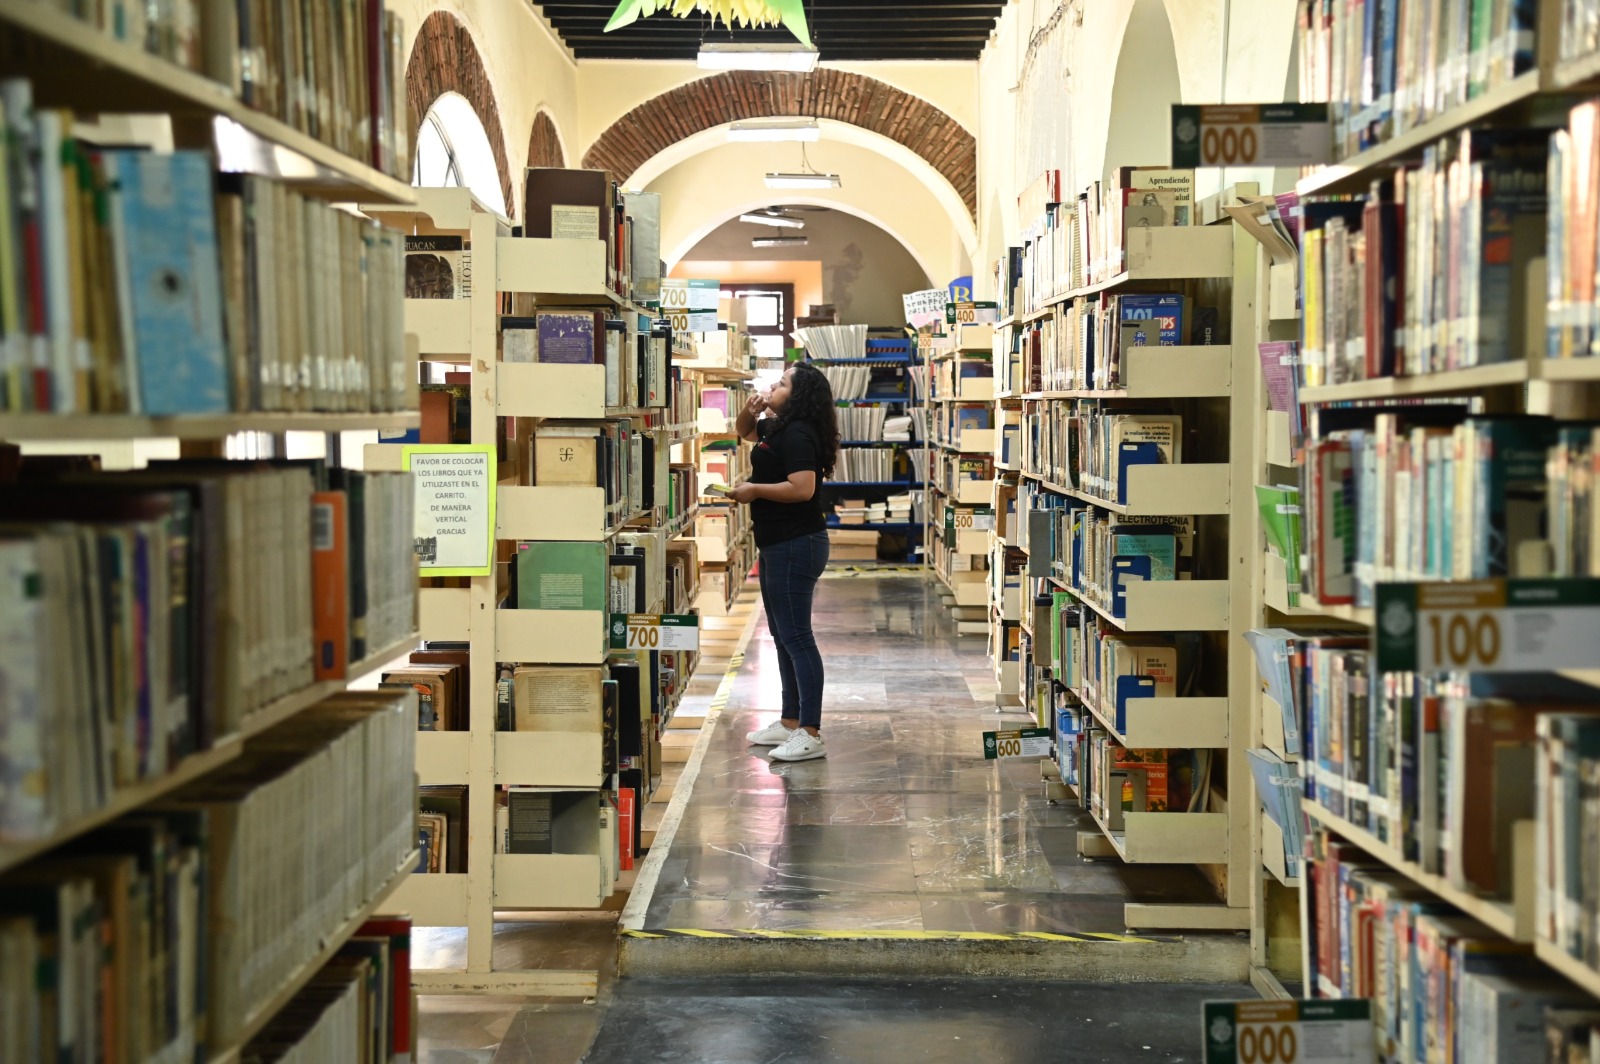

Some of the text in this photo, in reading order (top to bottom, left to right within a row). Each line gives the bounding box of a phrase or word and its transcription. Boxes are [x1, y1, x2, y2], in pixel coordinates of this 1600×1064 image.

[1203, 126, 1257, 164] 000
[1148, 176, 1190, 185] Aprendiendo
[662, 288, 687, 306] 700
[957, 310, 975, 322] 400
[955, 516, 973, 528] 500
[1117, 514, 1189, 525] ELECTROTECNIA
[629, 627, 658, 647] 700
[1429, 613, 1501, 666] 100
[998, 739, 1020, 757] 600
[1239, 1025, 1297, 1064] 000
